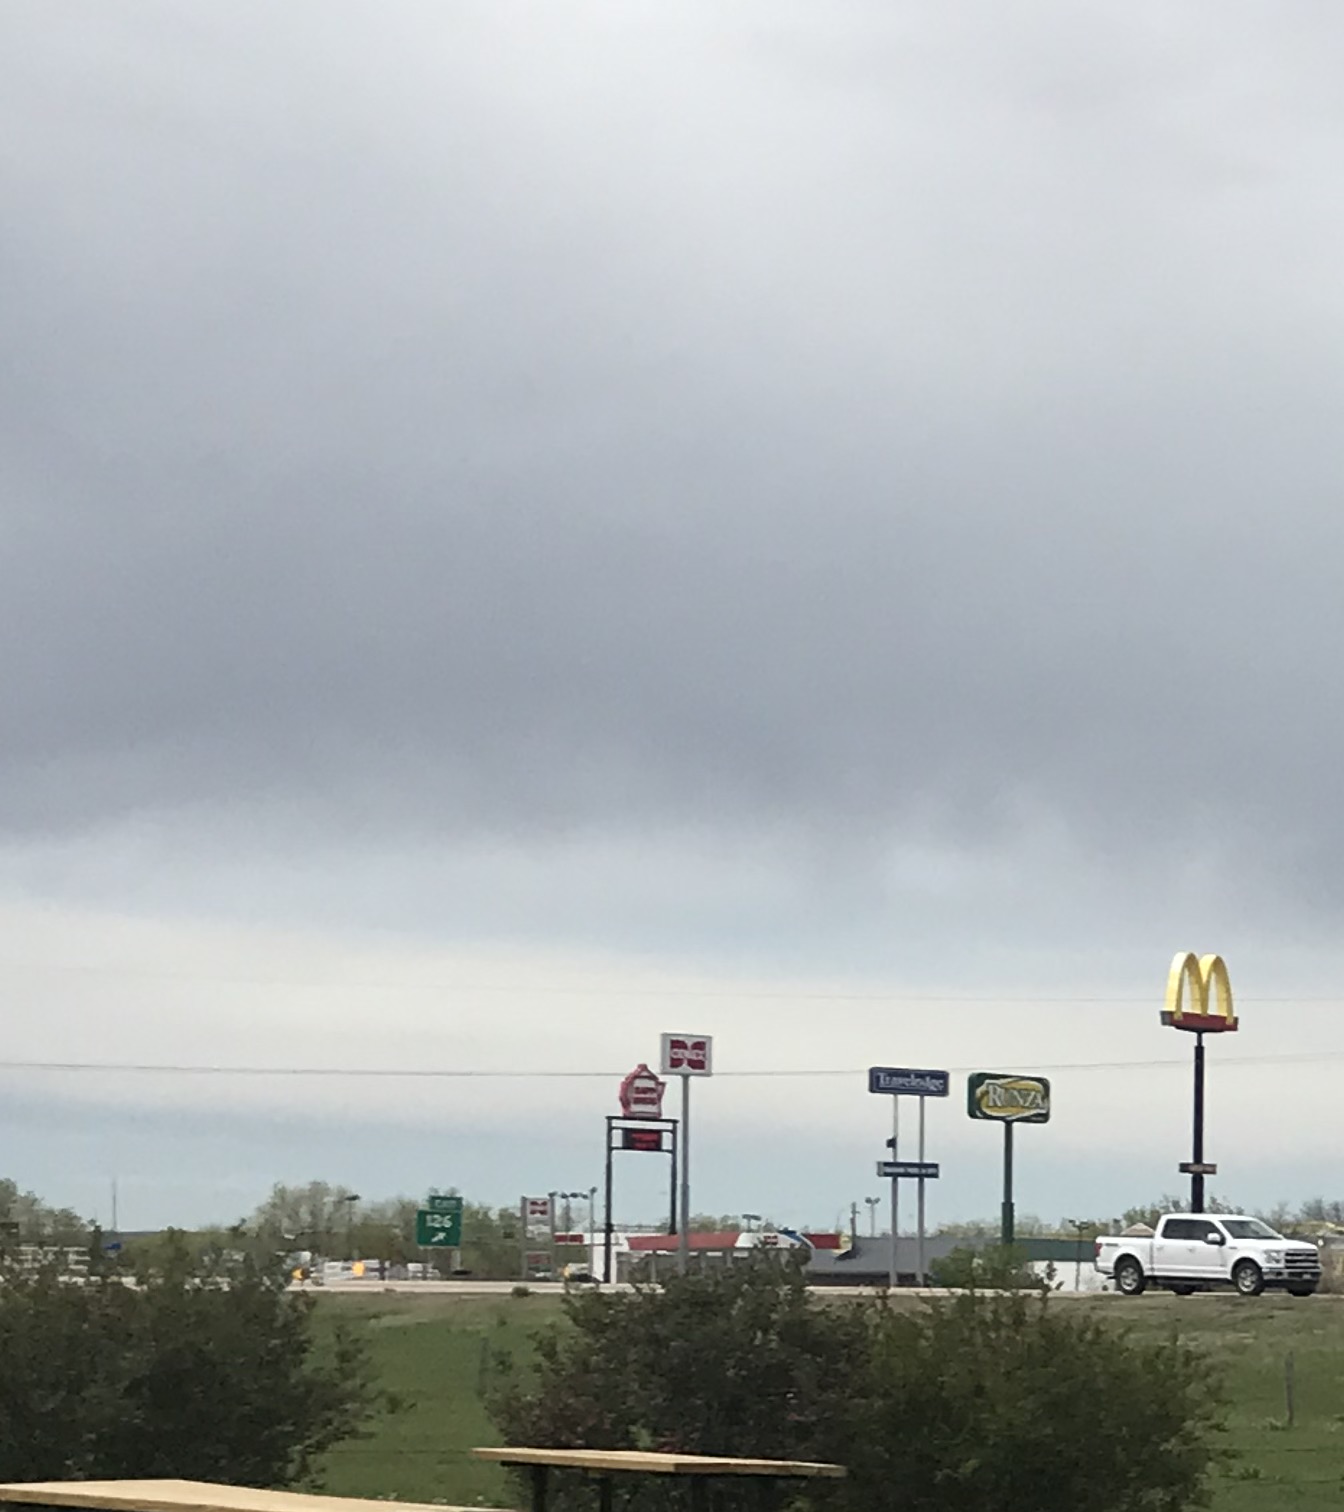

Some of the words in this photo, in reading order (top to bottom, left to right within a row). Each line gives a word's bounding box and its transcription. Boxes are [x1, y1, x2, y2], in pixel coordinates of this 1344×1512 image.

[877, 1072, 945, 1092] Travelodge
[988, 1082, 1045, 1109] RUNZA
[425, 1214, 453, 1228] 126
